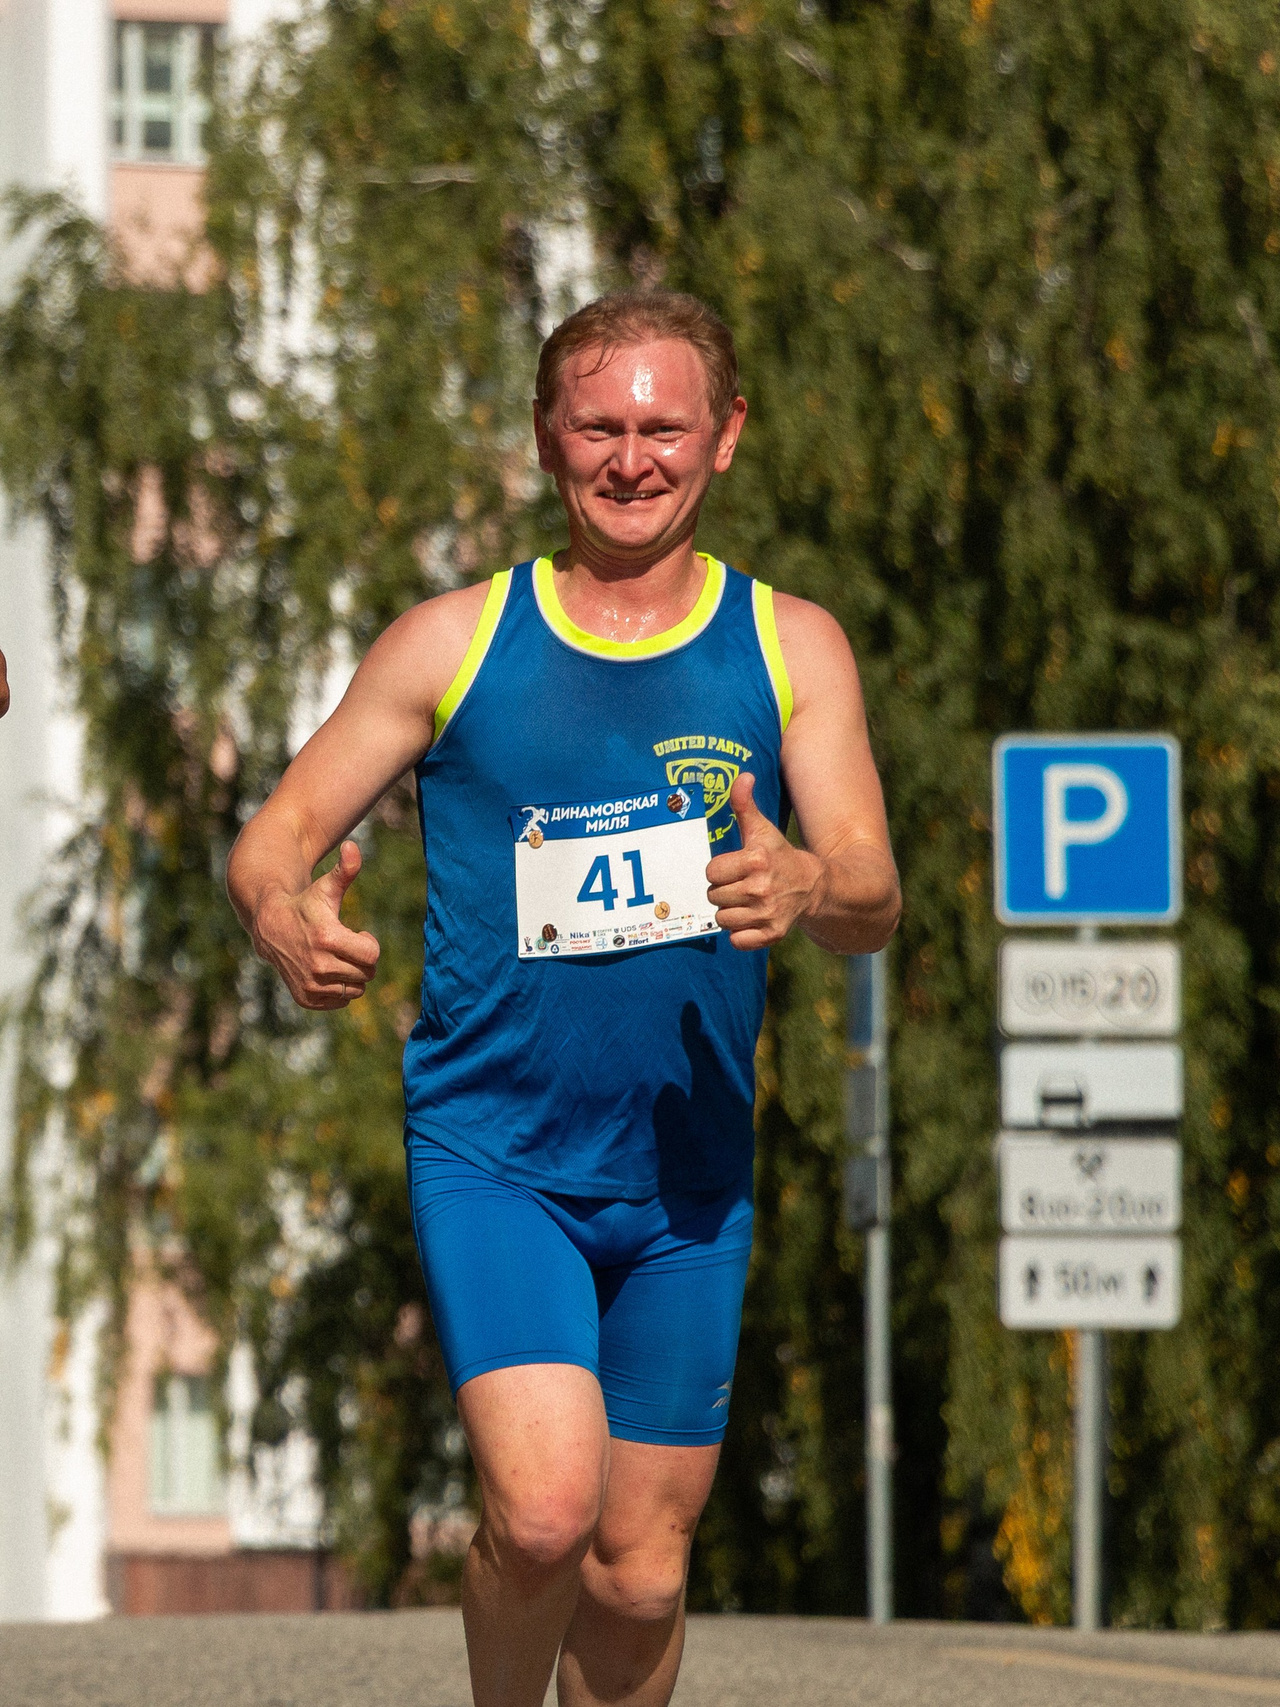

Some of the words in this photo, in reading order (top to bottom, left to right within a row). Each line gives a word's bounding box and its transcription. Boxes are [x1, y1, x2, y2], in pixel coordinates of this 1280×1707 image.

[652, 735, 706, 757] UNITED
[707, 735, 753, 762] PARTY
[550, 793, 659, 822] ДИНАМОВСКАЯ
[584, 815, 630, 833] МИЛЯ
[1042, 762, 1129, 900] P
[576, 849, 655, 911] 41
[569, 931, 590, 940] Nika
[620, 924, 637, 933] UDS
[628, 937, 649, 947] Effort
